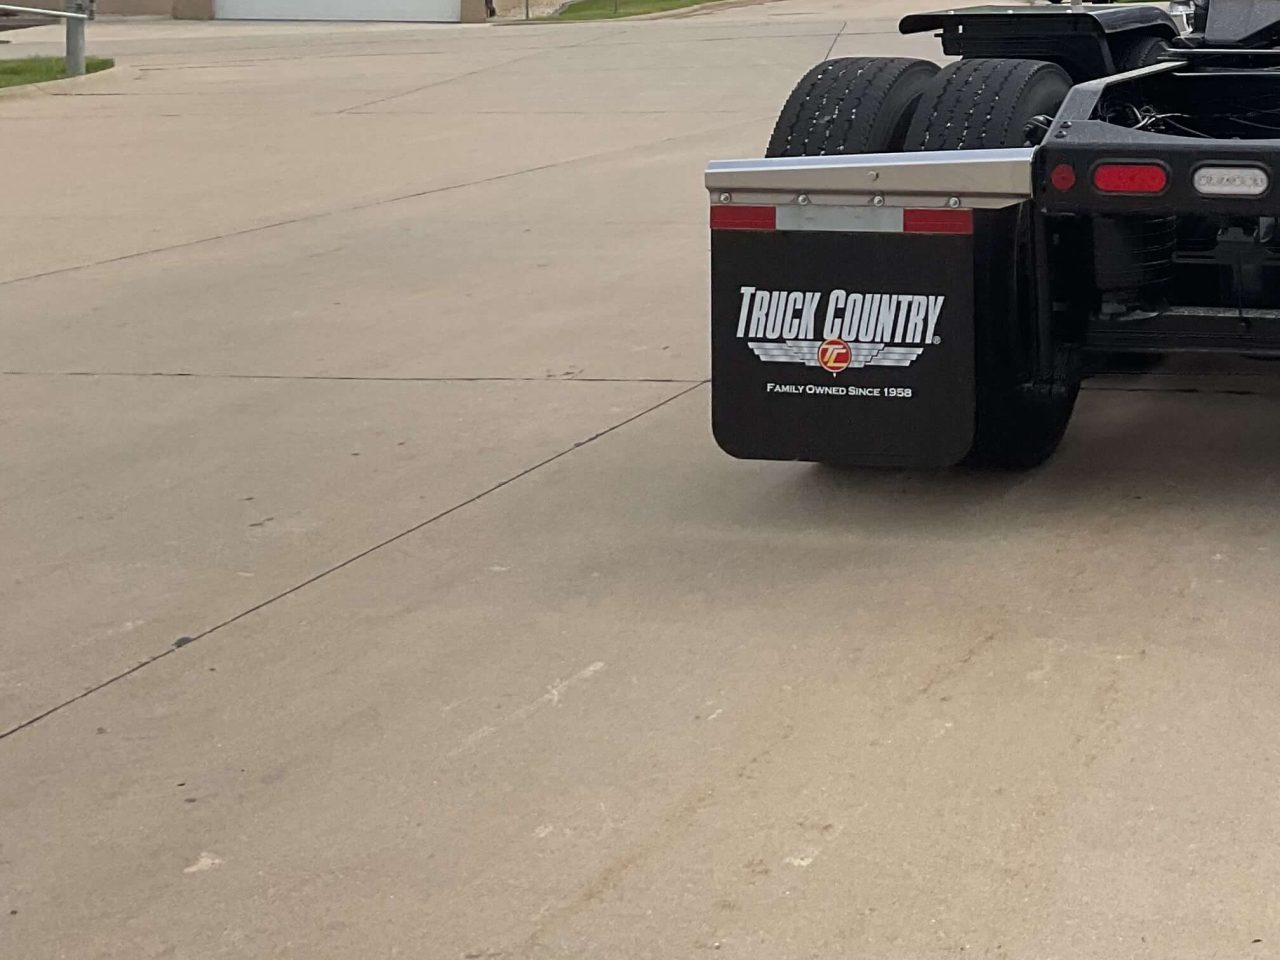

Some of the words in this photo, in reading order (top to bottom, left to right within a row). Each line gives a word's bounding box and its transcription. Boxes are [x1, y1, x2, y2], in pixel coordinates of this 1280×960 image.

[736, 286, 821, 339] TRUCK
[823, 289, 945, 344] COUNTRY
[766, 383, 804, 395] FAMILY
[806, 384, 847, 396] OWNED
[848, 386, 881, 397] SINCE
[883, 387, 913, 398] 1958
